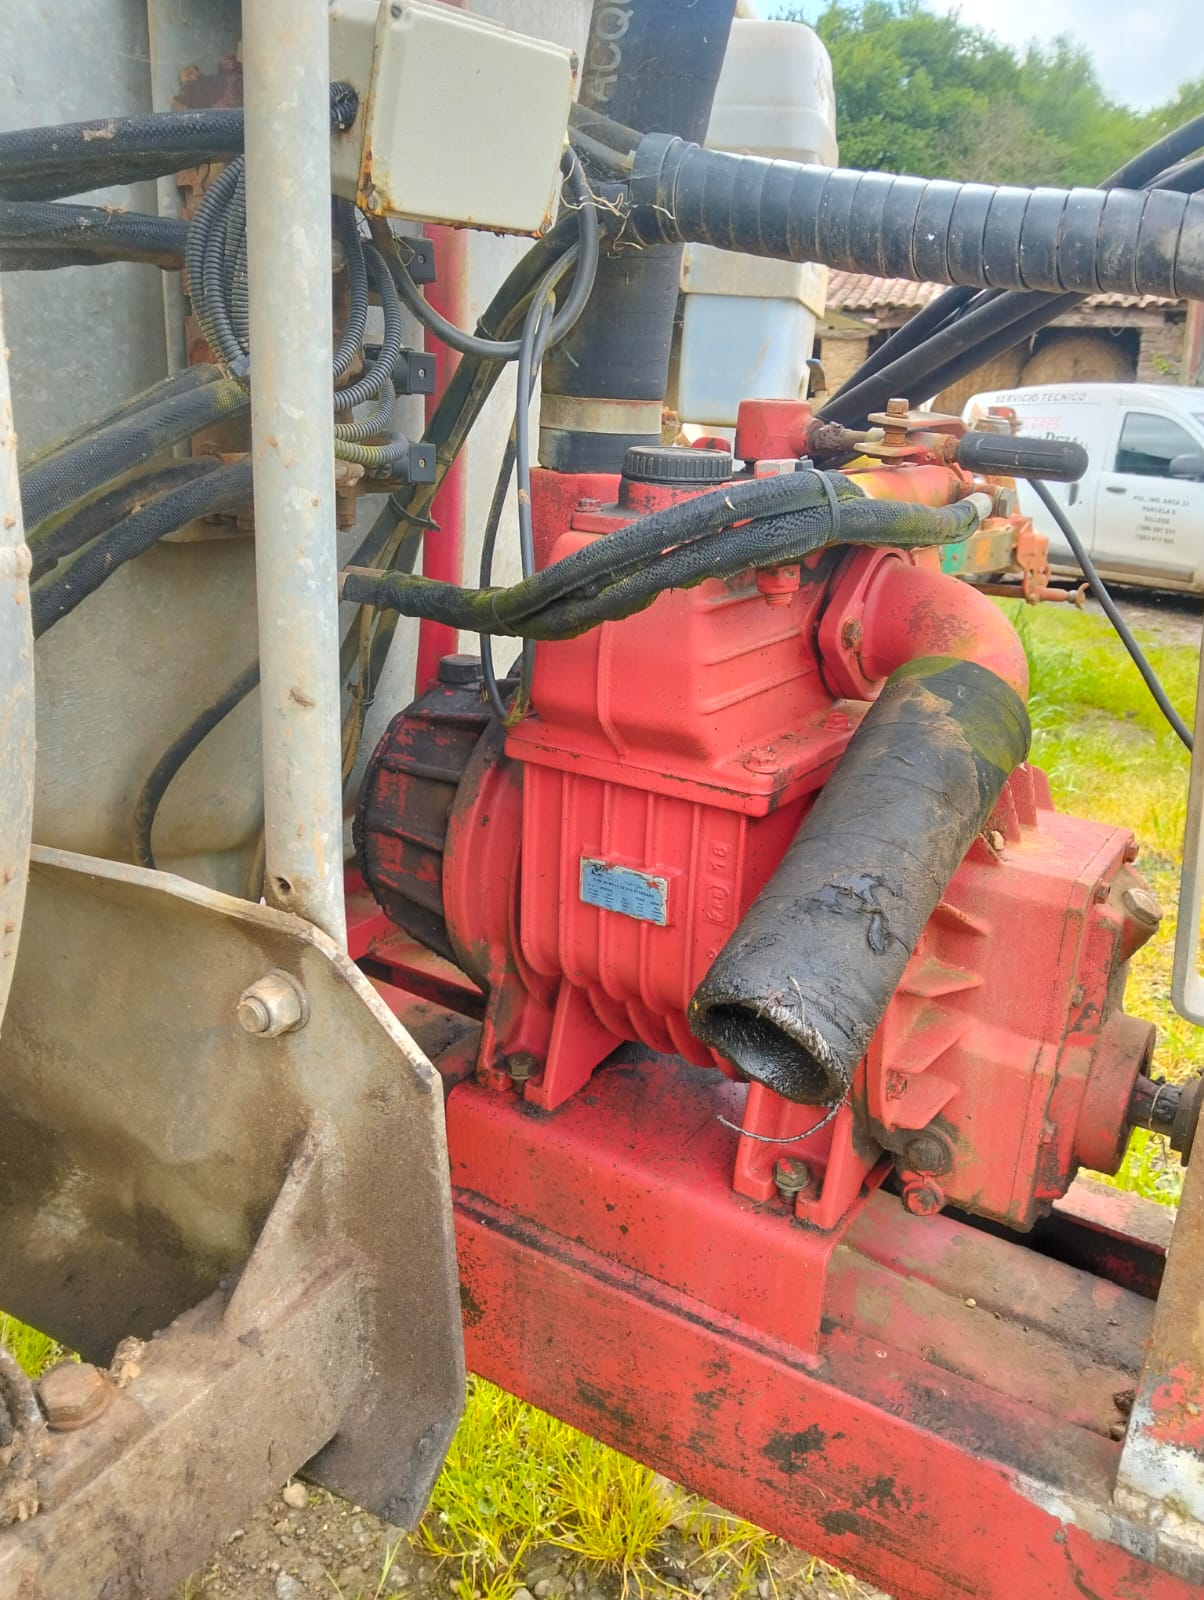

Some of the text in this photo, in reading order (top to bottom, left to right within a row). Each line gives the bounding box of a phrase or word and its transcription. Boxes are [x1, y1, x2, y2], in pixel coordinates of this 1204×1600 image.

[584, 0, 634, 102] ACQ
[994, 391, 1087, 403] SERVICIO TECNICO
